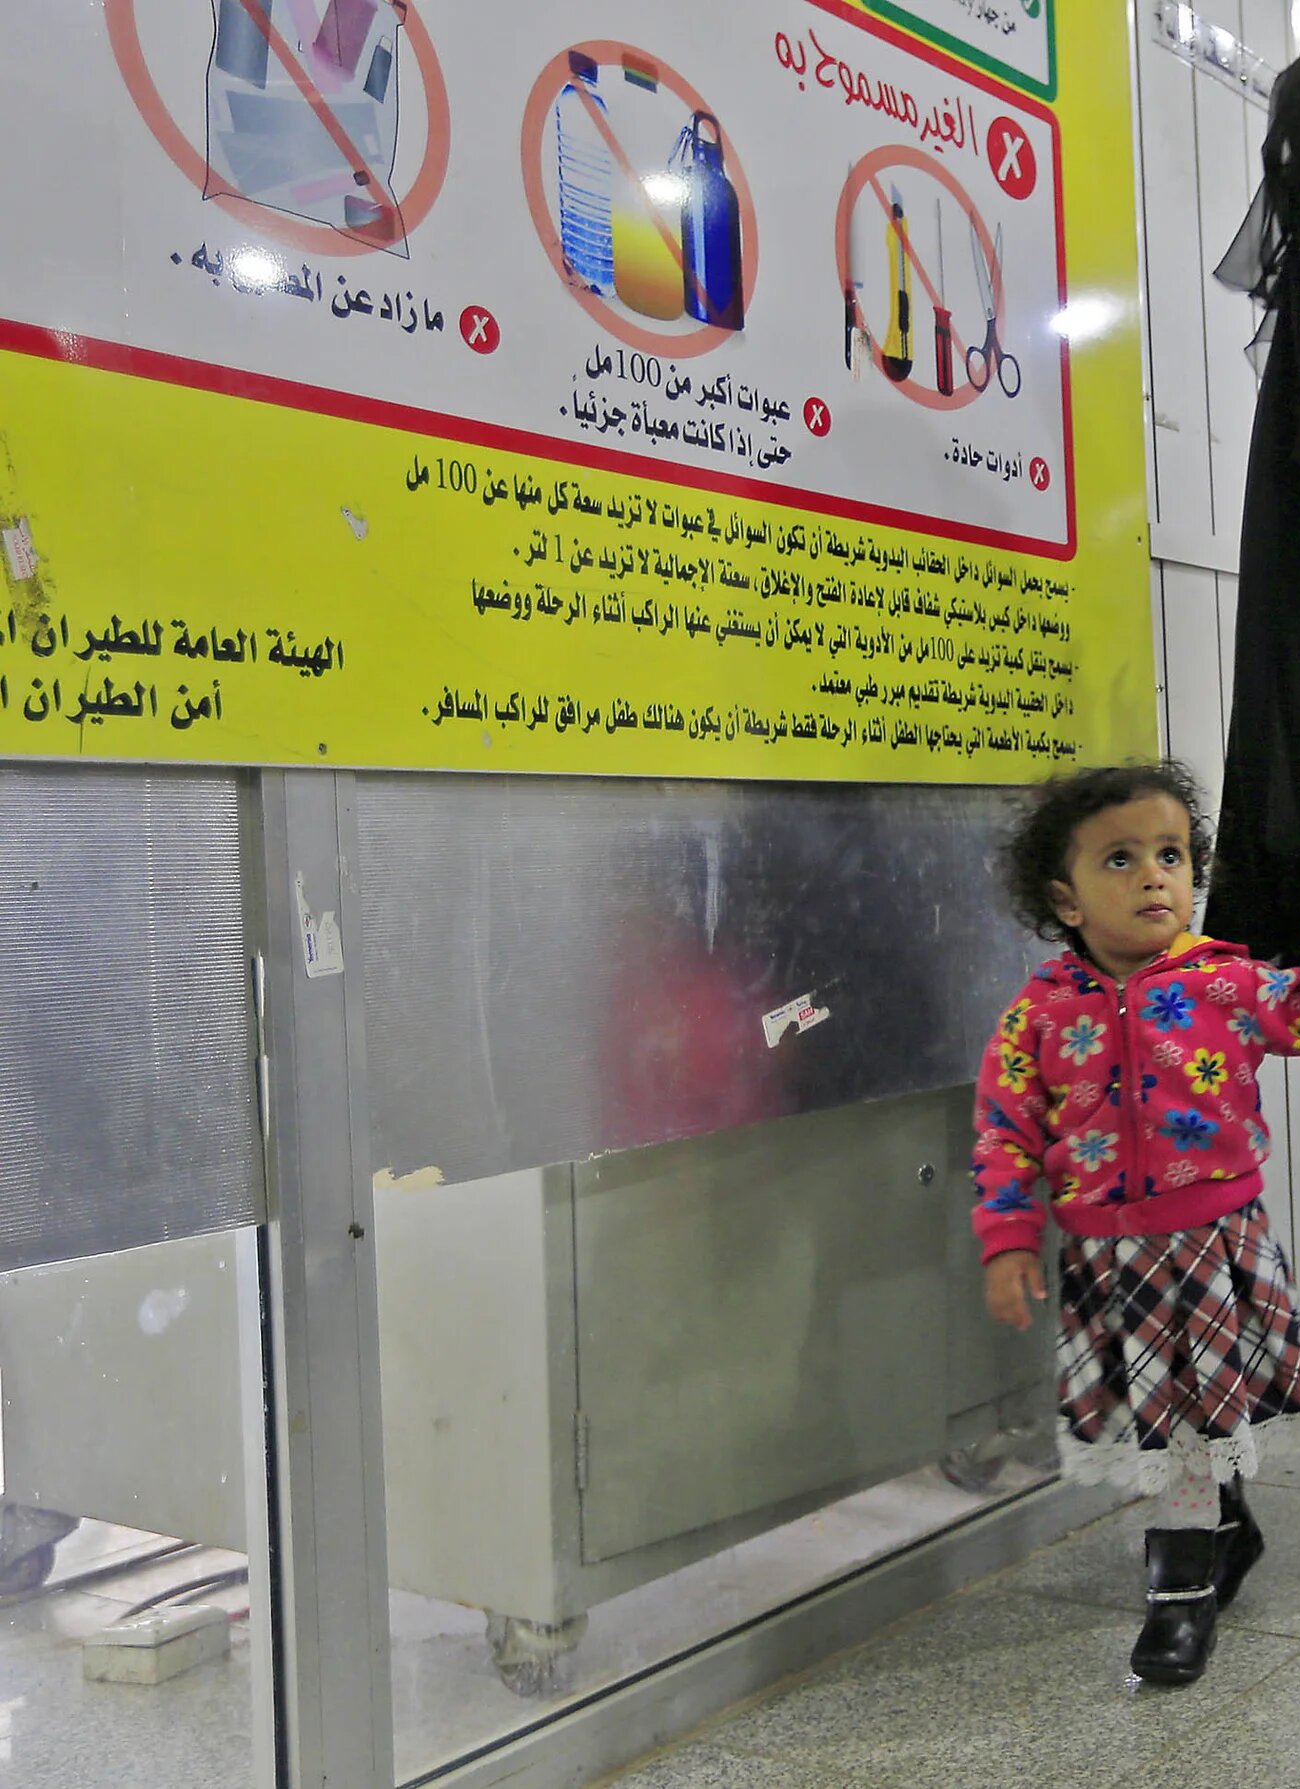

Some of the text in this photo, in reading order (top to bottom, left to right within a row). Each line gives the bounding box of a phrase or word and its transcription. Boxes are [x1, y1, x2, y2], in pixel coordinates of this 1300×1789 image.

[775, 29, 978, 155] الغير مسموح به
[331, 275, 374, 318] عن
[380, 290, 418, 334] زاد
[423, 298, 444, 332] ما
[666, 364, 692, 400] من
[695, 374, 732, 411] أكبر
[737, 384, 790, 425] عبوات
[632, 400, 679, 445] معبأة
[682, 418, 726, 451] كانت
[729, 427, 753, 466] إذا
[757, 436, 792, 468] حتى
[406, 455, 429, 491] مل
[436, 458, 477, 494] 100
[986, 451, 1022, 481] أدوات
[483, 469, 508, 506] عن
[514, 474, 542, 510] منها
[548, 481, 568, 515] كل
[572, 482, 602, 516] سعة
[607, 494, 642, 528] تزيد
[647, 498, 657, 524] لا
[662, 504, 704, 540] عبوات
[707, 507, 721, 542] في
[725, 512, 772, 548] السوائل
[776, 525, 806, 556] تكون
[810, 526, 822, 560] أن
[570, 538, 593, 573] عن
[599, 544, 634, 580] تزيد
[638, 548, 648, 574] لا
[826, 530, 865, 566] شريطة
[868, 538, 908, 574] اليدوية
[912, 547, 950, 576] الحقائب
[654, 549, 715, 592] الإجمالية
[954, 556, 978, 583] داخل
[982, 560, 1016, 591] السوائل
[1020, 570, 1042, 598] بحمل
[472, 578, 533, 621] ووضعها
[536, 583, 586, 626] الرحلة
[592, 591, 626, 624] أثناء
[816, 576, 846, 608] الفتح
[850, 581, 884, 616] لإعادة
[889, 588, 910, 618] قابل
[914, 588, 940, 617] شفاف
[632, 598, 679, 635] الراكب
[684, 606, 710, 639] عنها
[715, 609, 761, 647] يستغني
[766, 612, 778, 647] أن
[944, 597, 986, 630] بلاستيكي
[990, 605, 1010, 633] كيس
[1014, 608, 1036, 634] داخل
[1040, 613, 1070, 642] ووضعها
[170, 619, 258, 663] العامة
[784, 618, 812, 652] يمكن
[815, 622, 824, 646] لا
[829, 625, 851, 659] التي
[854, 626, 894, 659] الأدوية
[900, 634, 912, 662] من
[264, 628, 344, 677] الهيئة
[958, 642, 975, 669] على
[978, 644, 1000, 672] تزيد
[1002, 646, 1024, 674] كمية
[1027, 651, 1046, 678] بنقل
[23, 676, 158, 726] الطيران
[170, 679, 223, 730] أمن
[856, 674, 878, 707] طبي
[882, 683, 905, 707] مبرر
[908, 680, 939, 708] تقديم
[942, 680, 976, 712] شريطة
[978, 684, 1014, 715] اليدوية
[1015, 688, 1048, 717] الحقيبة
[494, 692, 550, 730] للراكب
[554, 696, 600, 732] مرافق
[605, 697, 638, 734] طفل
[642, 702, 684, 731] هنالك
[688, 705, 721, 742] يكون
[725, 704, 740, 740] أن
[742, 706, 787, 744] شريطة
[791, 709, 817, 739] فقط
[819, 714, 856, 748] الرحلة
[862, 716, 886, 746] أثناء
[890, 720, 922, 750] الطفل
[925, 724, 962, 754] يحتاجها
[966, 726, 984, 758] التي
[988, 725, 1024, 752] الأطعمة
